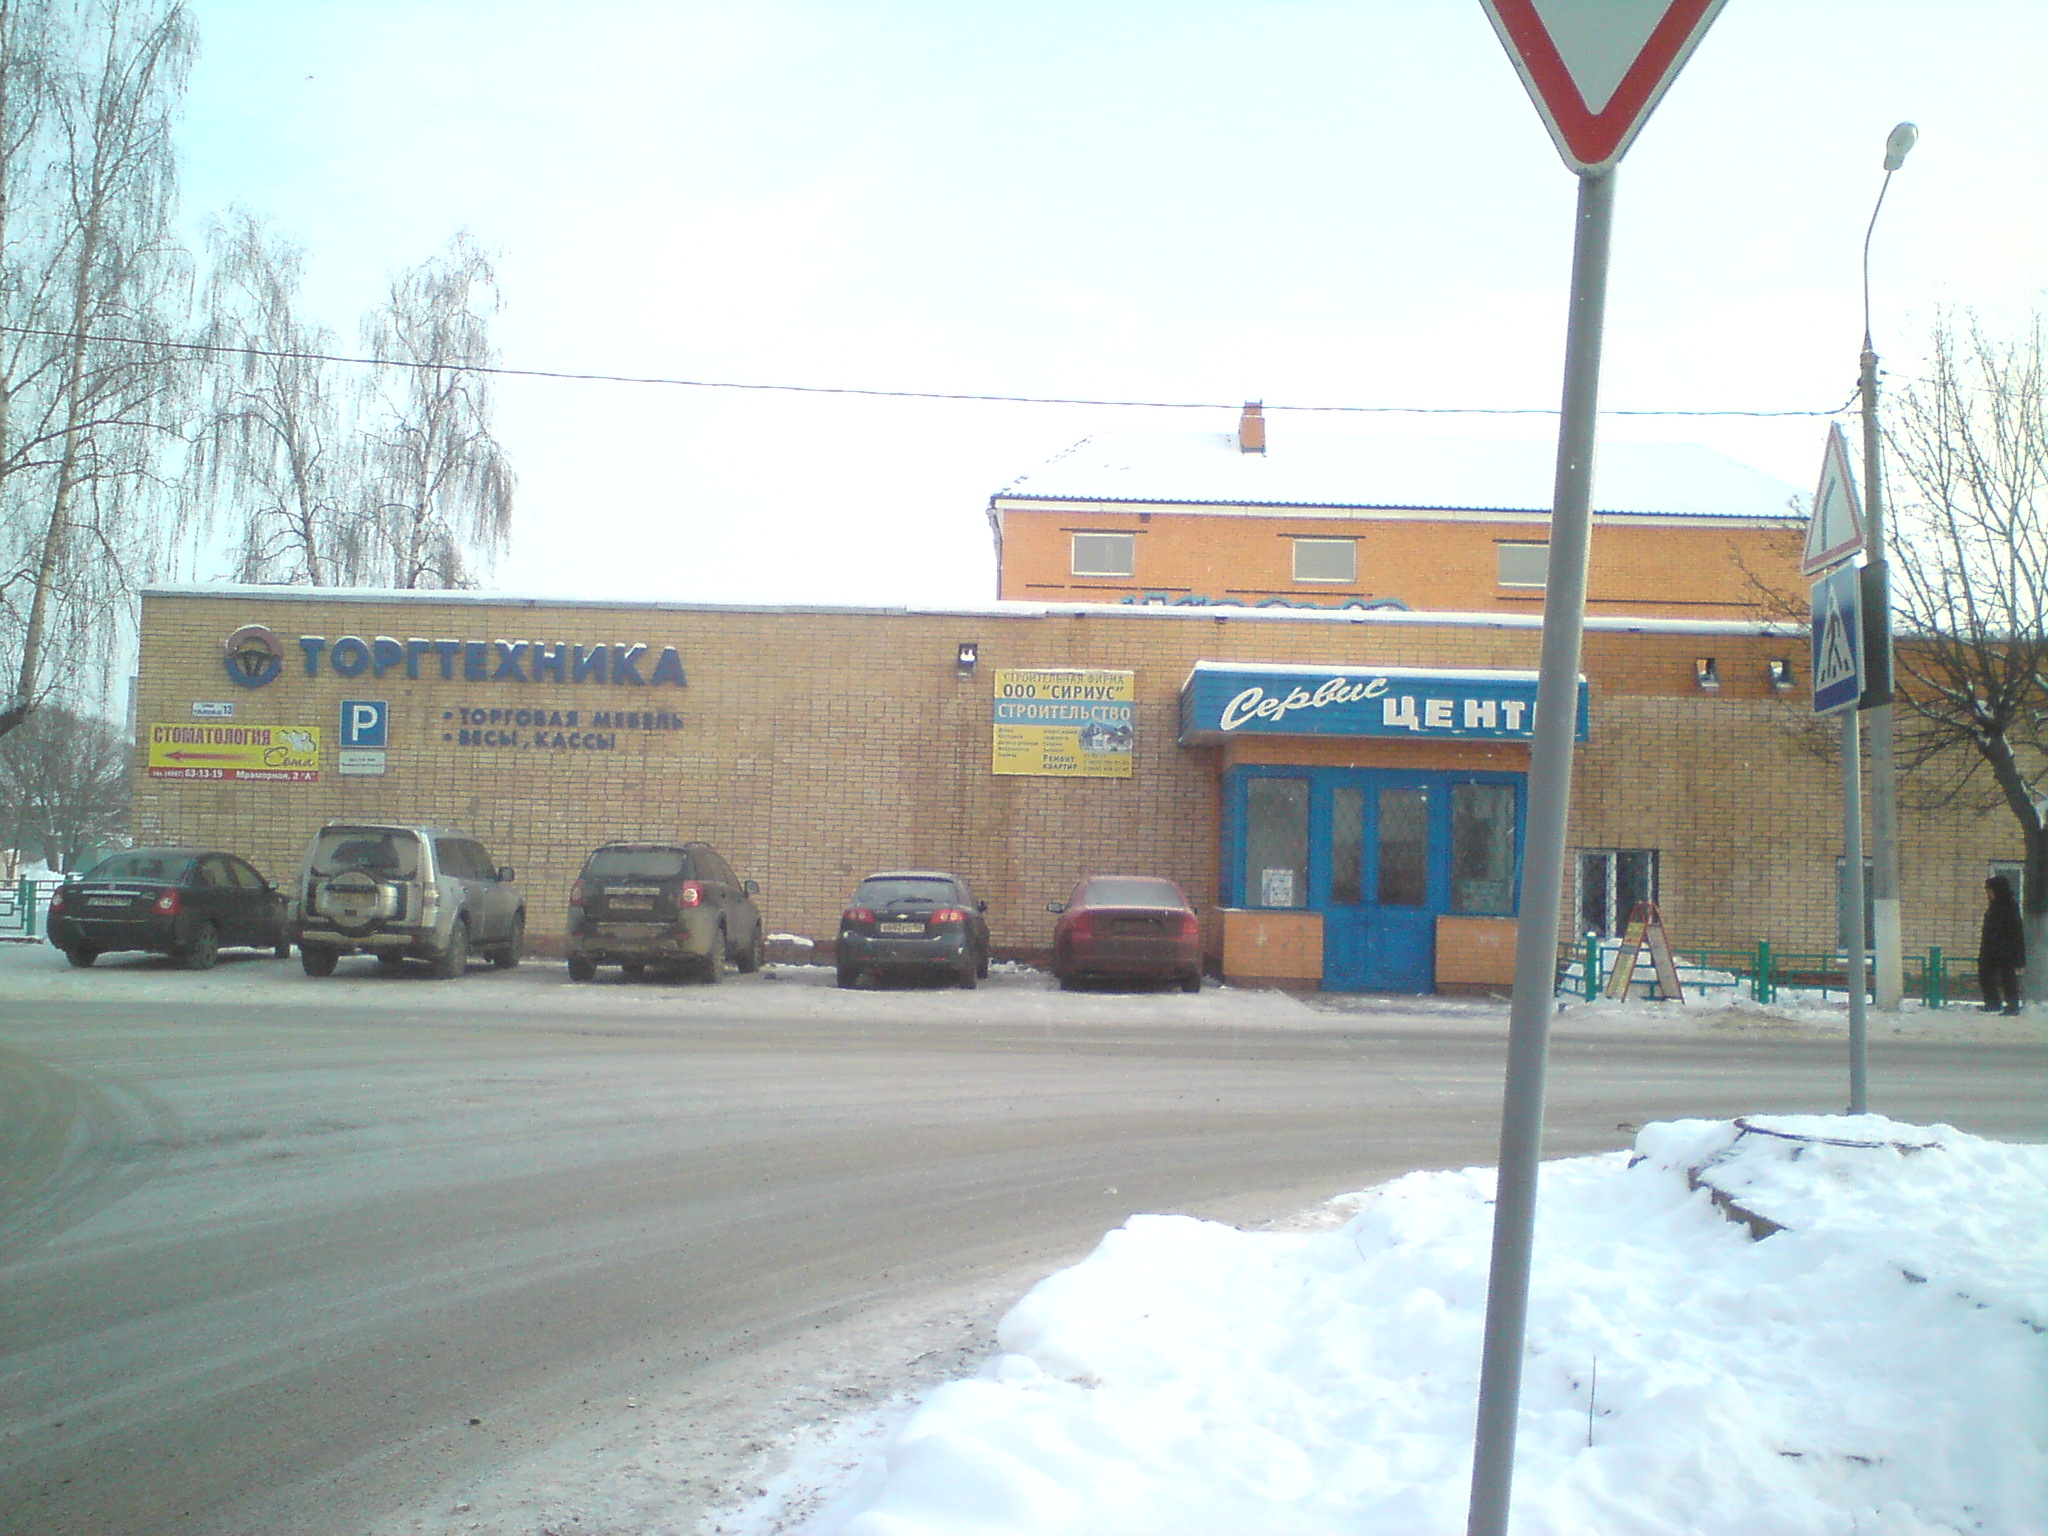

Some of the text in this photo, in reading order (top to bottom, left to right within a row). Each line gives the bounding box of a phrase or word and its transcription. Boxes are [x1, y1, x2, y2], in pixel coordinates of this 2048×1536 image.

[299, 635, 687, 687] ТОРГТЕХНИКА
[1003, 672, 1124, 686] СТРОИТЕЛЬНАЯ ФИРМА
[1003, 683, 1036, 698] ООО
[998, 703, 1131, 721] СТРОИТЕЛЬСТВО
[1220, 677, 1390, 732] Сервис
[1382, 695, 1537, 731] ЦЕНТ
[352, 705, 378, 741] P
[460, 707, 685, 731] ТОРГОВАЯ МЕБЕЛЬ
[154, 726, 271, 746] СТОМАТОЛОГИЯ
[534, 731, 617, 751] КАССЫ
